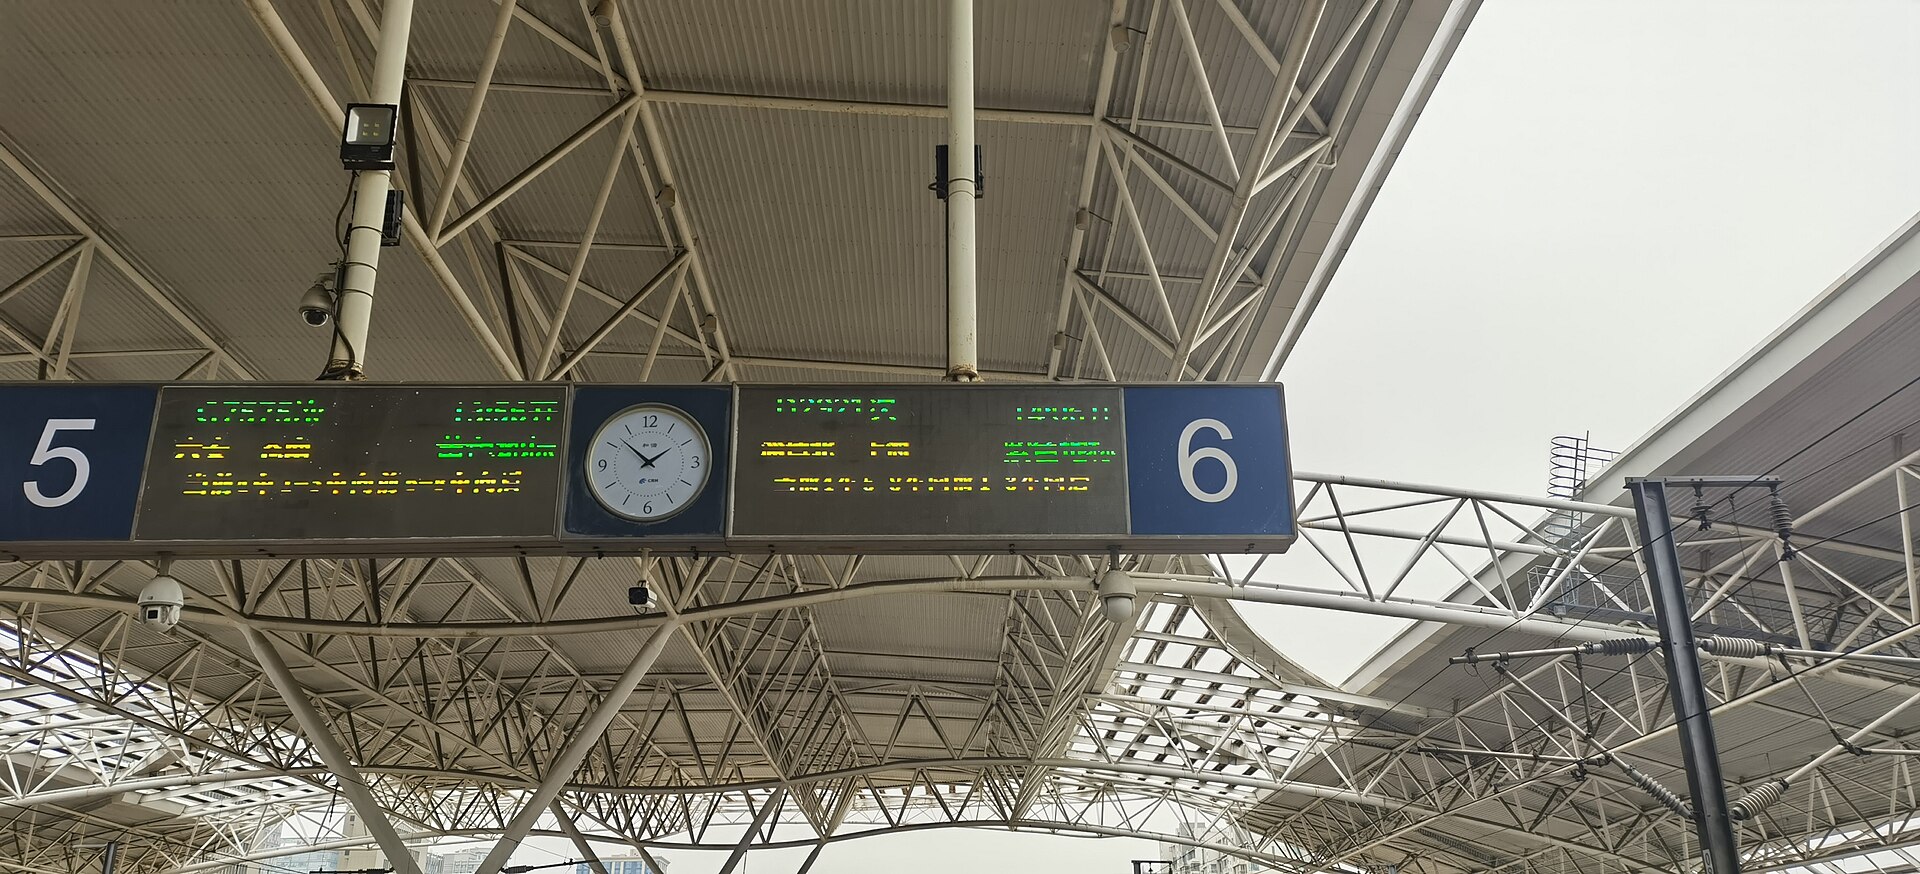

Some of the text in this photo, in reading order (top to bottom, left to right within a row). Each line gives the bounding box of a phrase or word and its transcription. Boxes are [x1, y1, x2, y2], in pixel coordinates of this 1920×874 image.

[643, 415, 658, 428] 12
[23, 418, 96, 508] 5
[598, 459, 607, 473] 9
[691, 456, 700, 468] 3
[1178, 418, 1238, 503] 6
[643, 501, 653, 514] 6
